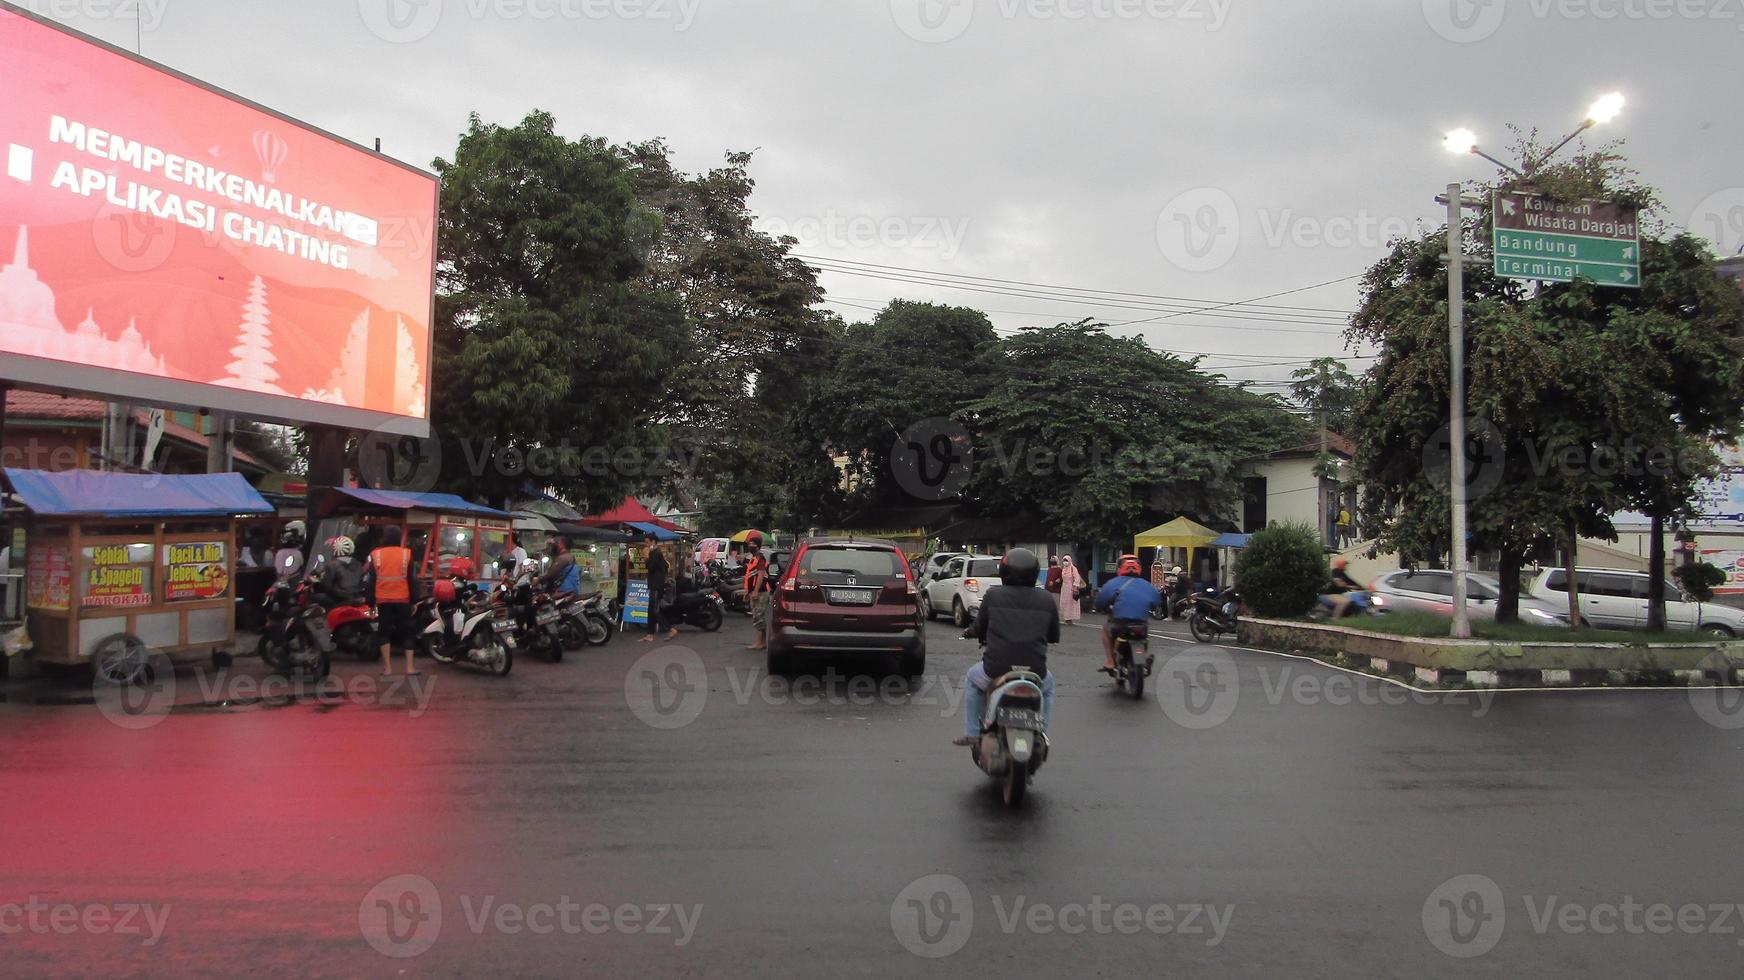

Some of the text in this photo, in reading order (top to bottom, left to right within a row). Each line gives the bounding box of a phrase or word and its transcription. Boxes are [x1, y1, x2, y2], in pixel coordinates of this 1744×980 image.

[50, 113, 350, 236] MEMPERKENALKAN
[51, 161, 349, 270] APLIKASI CHATING
[1524, 196, 1591, 215] Kawaan
[1525, 213, 1634, 238] Wisata Darajat
[1501, 235, 1577, 257] Bandung
[1501, 259, 1579, 278] Terminal
[94, 546, 129, 565] Seblak
[91, 567, 143, 587] & Spagetti
